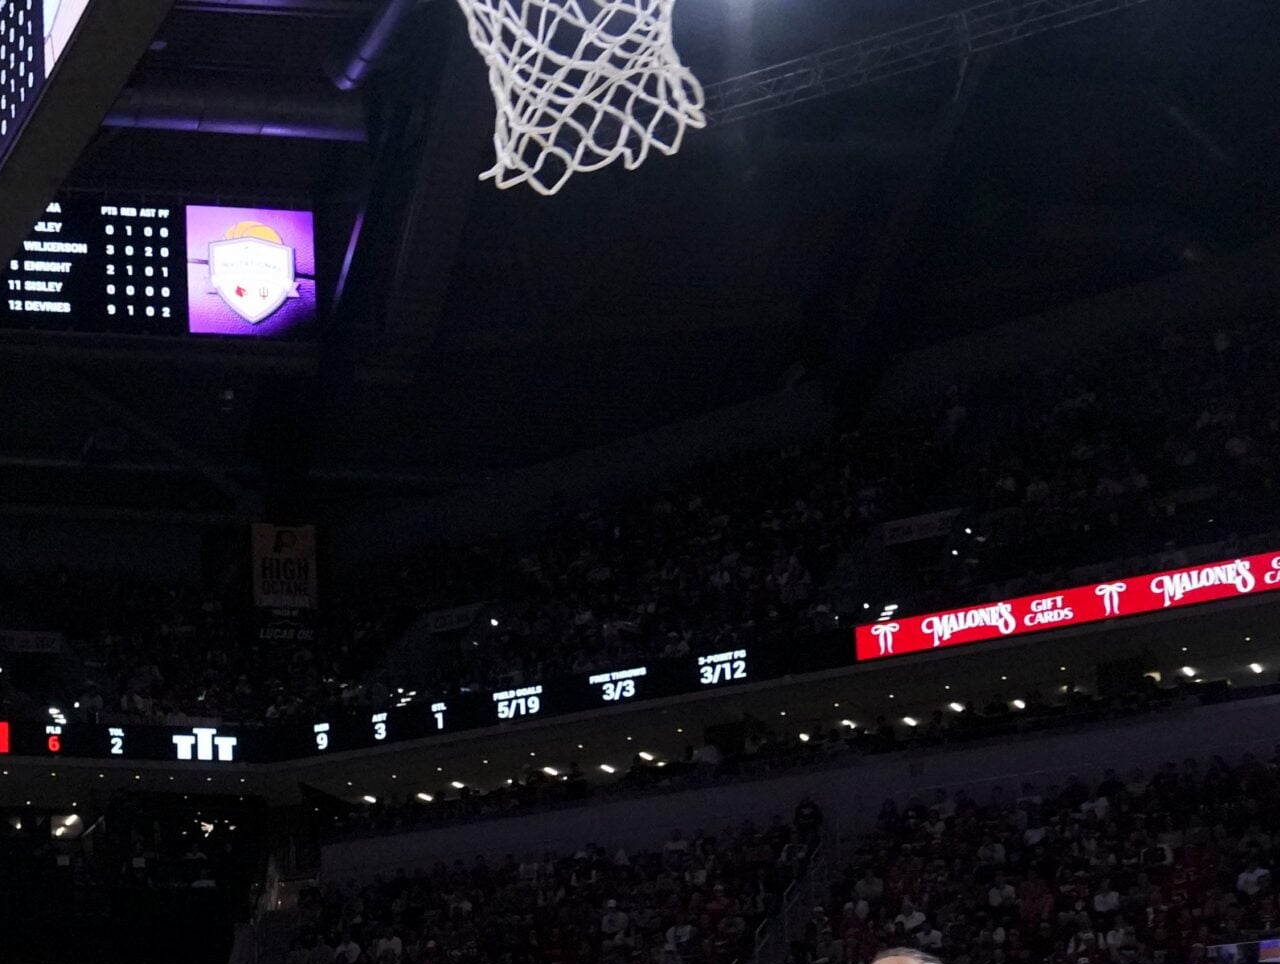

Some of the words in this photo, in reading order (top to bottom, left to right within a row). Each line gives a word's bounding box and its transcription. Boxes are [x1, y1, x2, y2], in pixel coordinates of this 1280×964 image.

[101, 206, 118, 215] PTS
[140, 208, 156, 217] AST
[158, 209, 169, 218] PF
[106, 225, 114, 235] 0
[126, 226, 132, 235] 1
[144, 227, 152, 236] 0
[160, 228, 168, 237] 0
[106, 245, 114, 255] 3
[125, 246, 133, 255] 0
[145, 247, 152, 256] 2
[160, 247, 169, 257] 0
[24, 261, 72, 273] ENRIGHT
[107, 265, 114, 274] 2
[127, 265, 132, 275] 1
[145, 266, 153, 276] 0
[162, 267, 168, 277] 1
[8, 280, 20, 290] 11
[24, 281, 62, 292] SISLEY
[107, 285, 115, 294] 0
[126, 285, 134, 295] 0
[146, 286, 154, 296] 0
[161, 287, 170, 297] 0
[8, 300, 22, 310] 12
[24, 301, 71, 312] DEVRIES
[107, 304, 115, 314] 9
[127, 305, 133, 315] 1
[146, 306, 154, 316] 0
[162, 307, 170, 317] 2
[1151, 559, 1255, 607] MALONE'S
[1031, 597, 1064, 612] GIFT
[921, 602, 1016, 646] MALONE'S
[1024, 606, 1074, 626] CARDS
[700, 660, 747, 684] 3/12
[602, 680, 636, 700] 3/3
[497, 696, 540, 718] 5/19
[434, 712, 444, 729] 1
[374, 722, 386, 740] 3
[48, 736, 60, 752] 6
[110, 738, 123, 754] 2
[316, 732, 328, 750] 9
